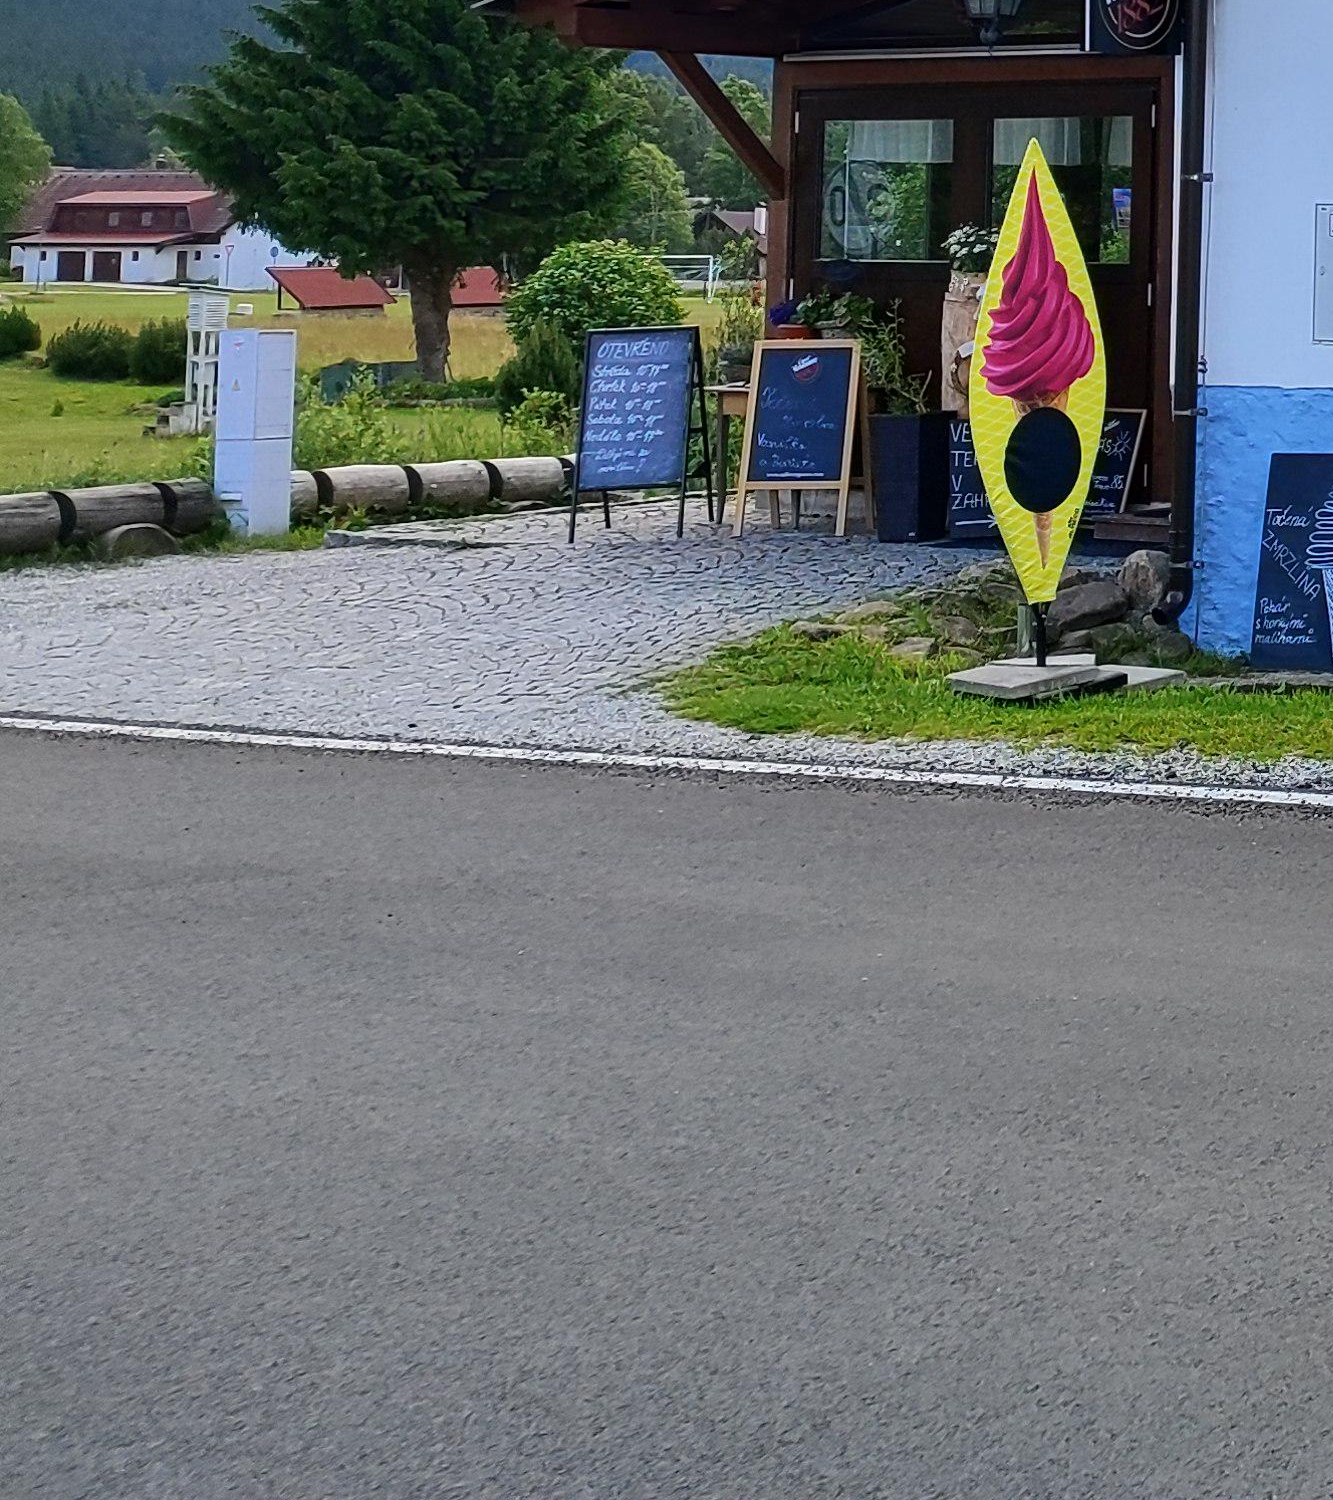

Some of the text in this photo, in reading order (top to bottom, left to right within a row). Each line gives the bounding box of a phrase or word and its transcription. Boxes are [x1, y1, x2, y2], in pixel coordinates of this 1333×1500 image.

[952, 474, 962, 491] V
[1266, 505, 1313, 528] Točená
[1262, 529, 1321, 601] ZMRZLINA
